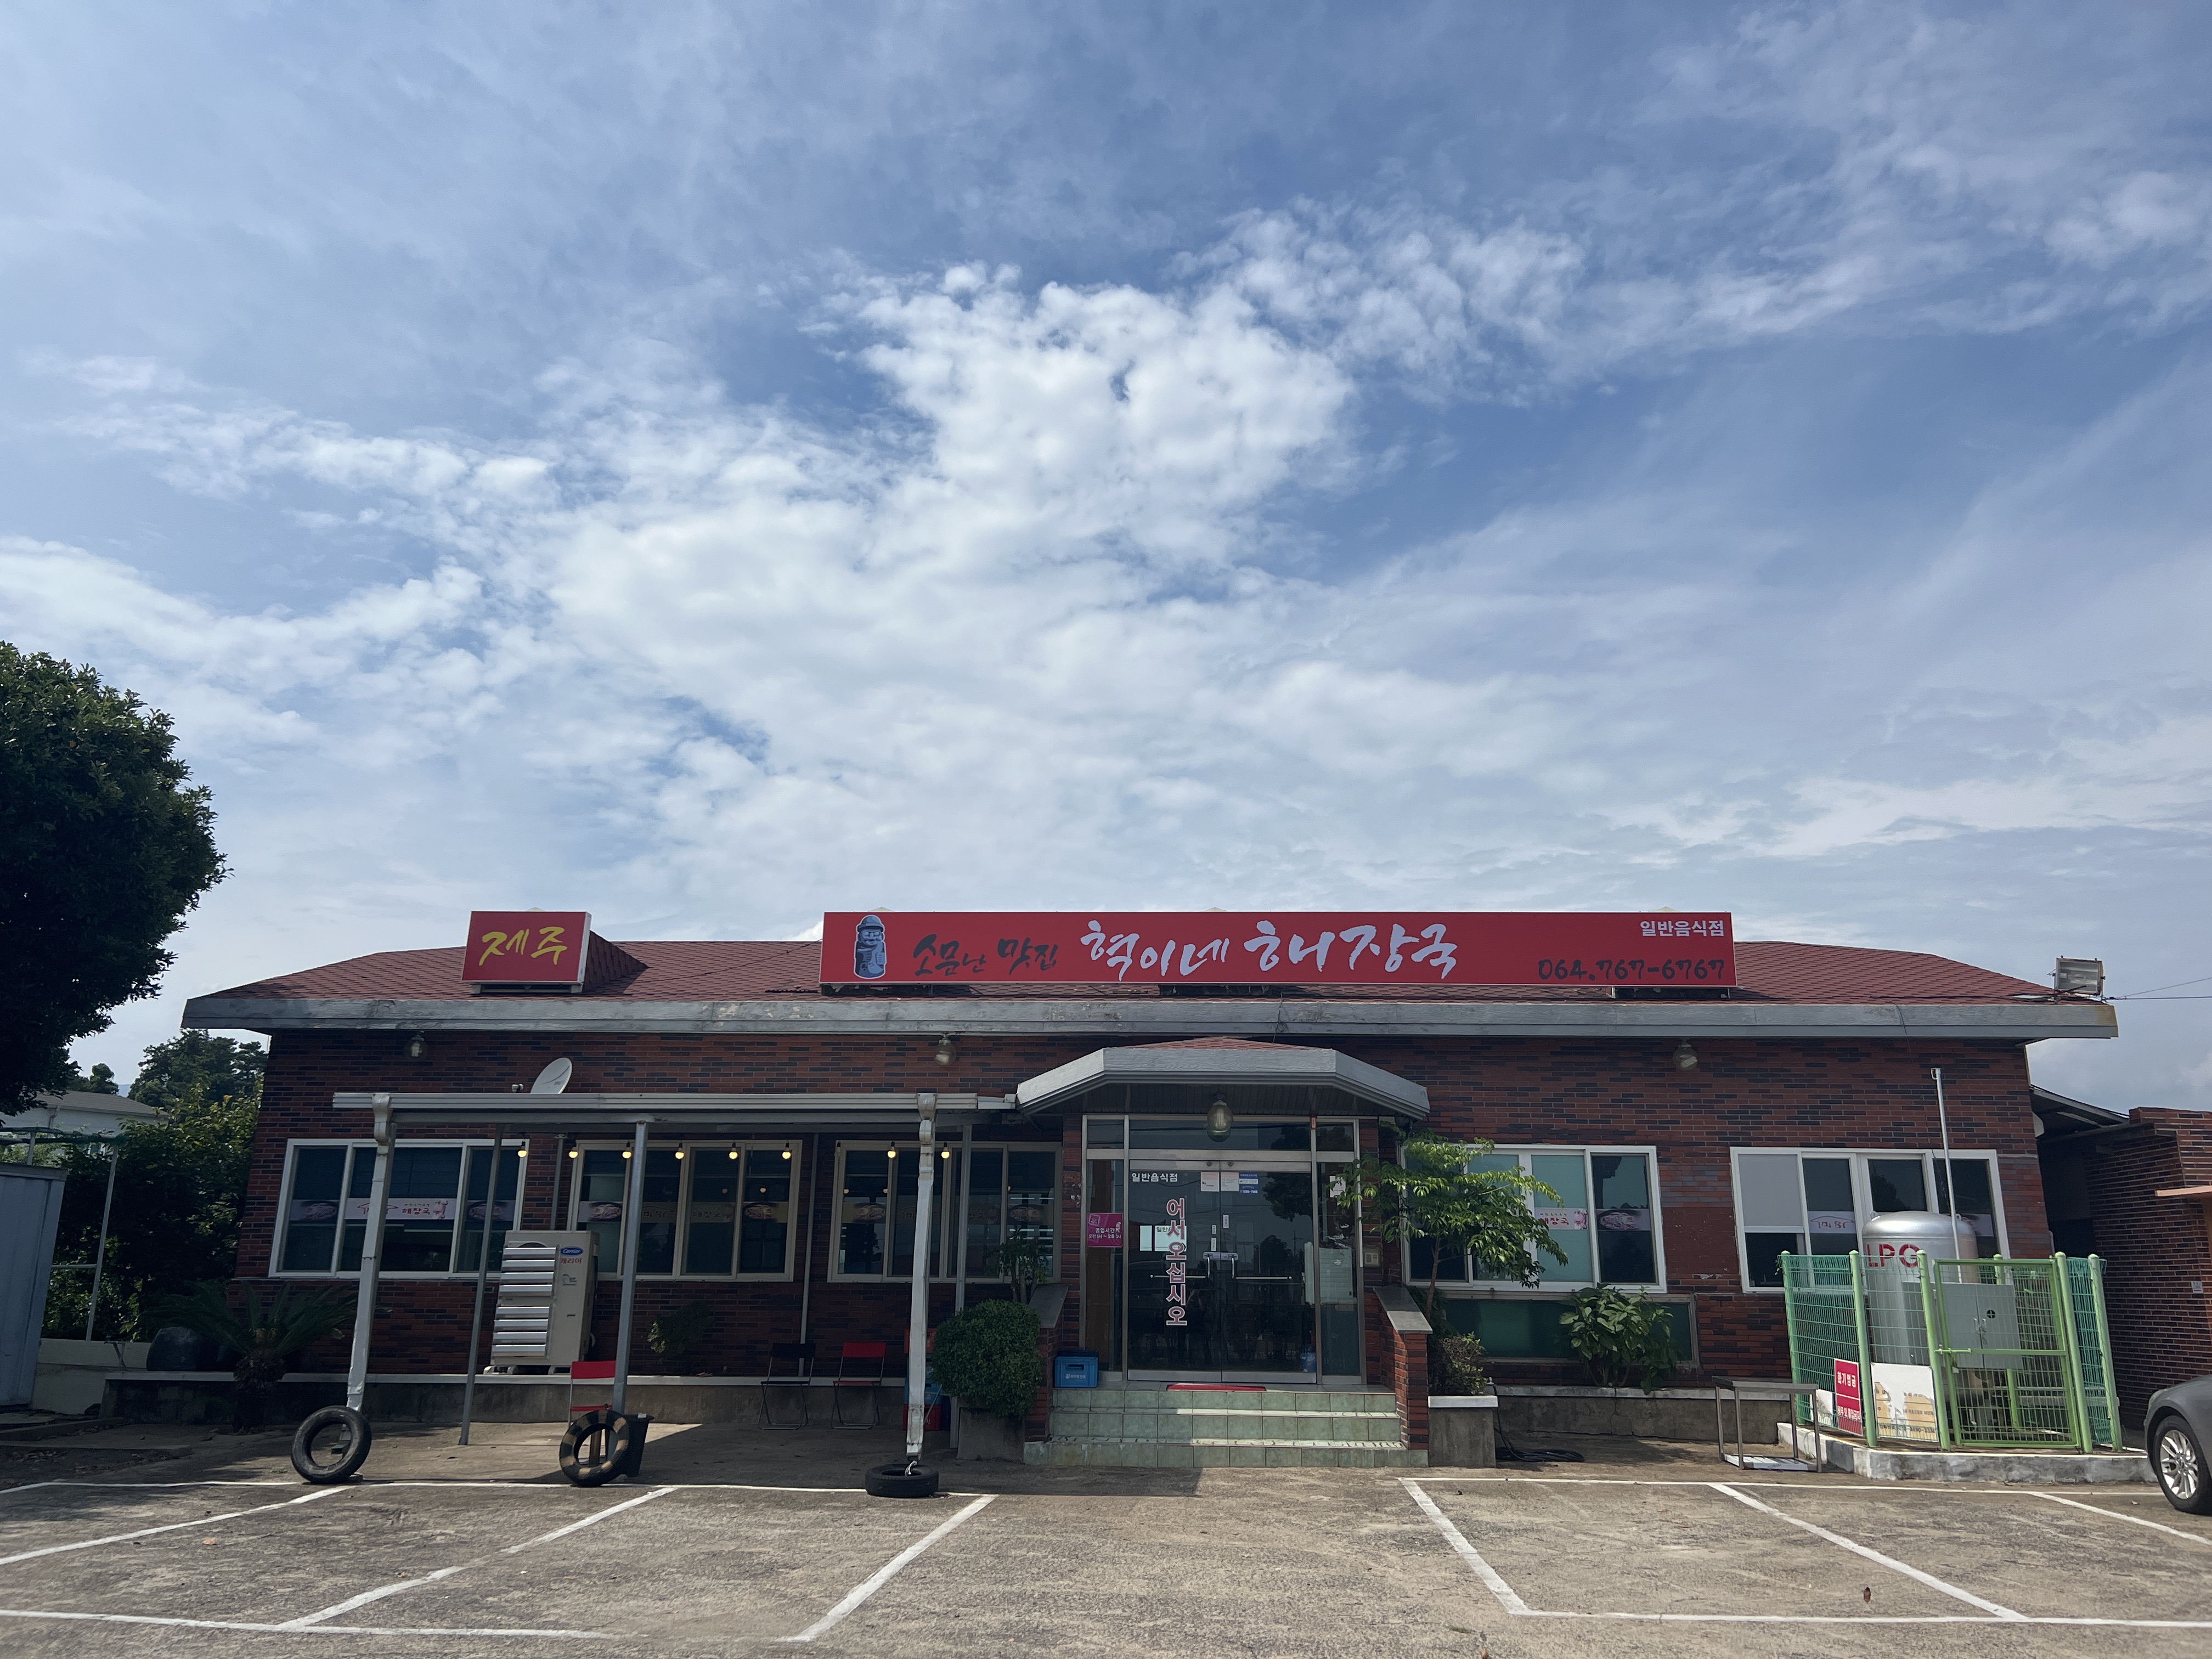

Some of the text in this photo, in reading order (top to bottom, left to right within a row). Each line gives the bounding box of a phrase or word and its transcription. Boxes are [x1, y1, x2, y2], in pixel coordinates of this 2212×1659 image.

[1640, 920, 1724, 937] 일반음식점
[479, 926, 568, 966] 제주
[913, 919, 1458, 981] 소문난 맛집 혁이네 해장국
[1538, 959, 1725, 981] 064.767-6767
[1131, 1172, 1178, 1182] 일반음식점
[1166, 1198, 1188, 1326] 어서오십시오
[1866, 1244, 1921, 1268] LPG
[1837, 1371, 1857, 1388] 화기엄금
